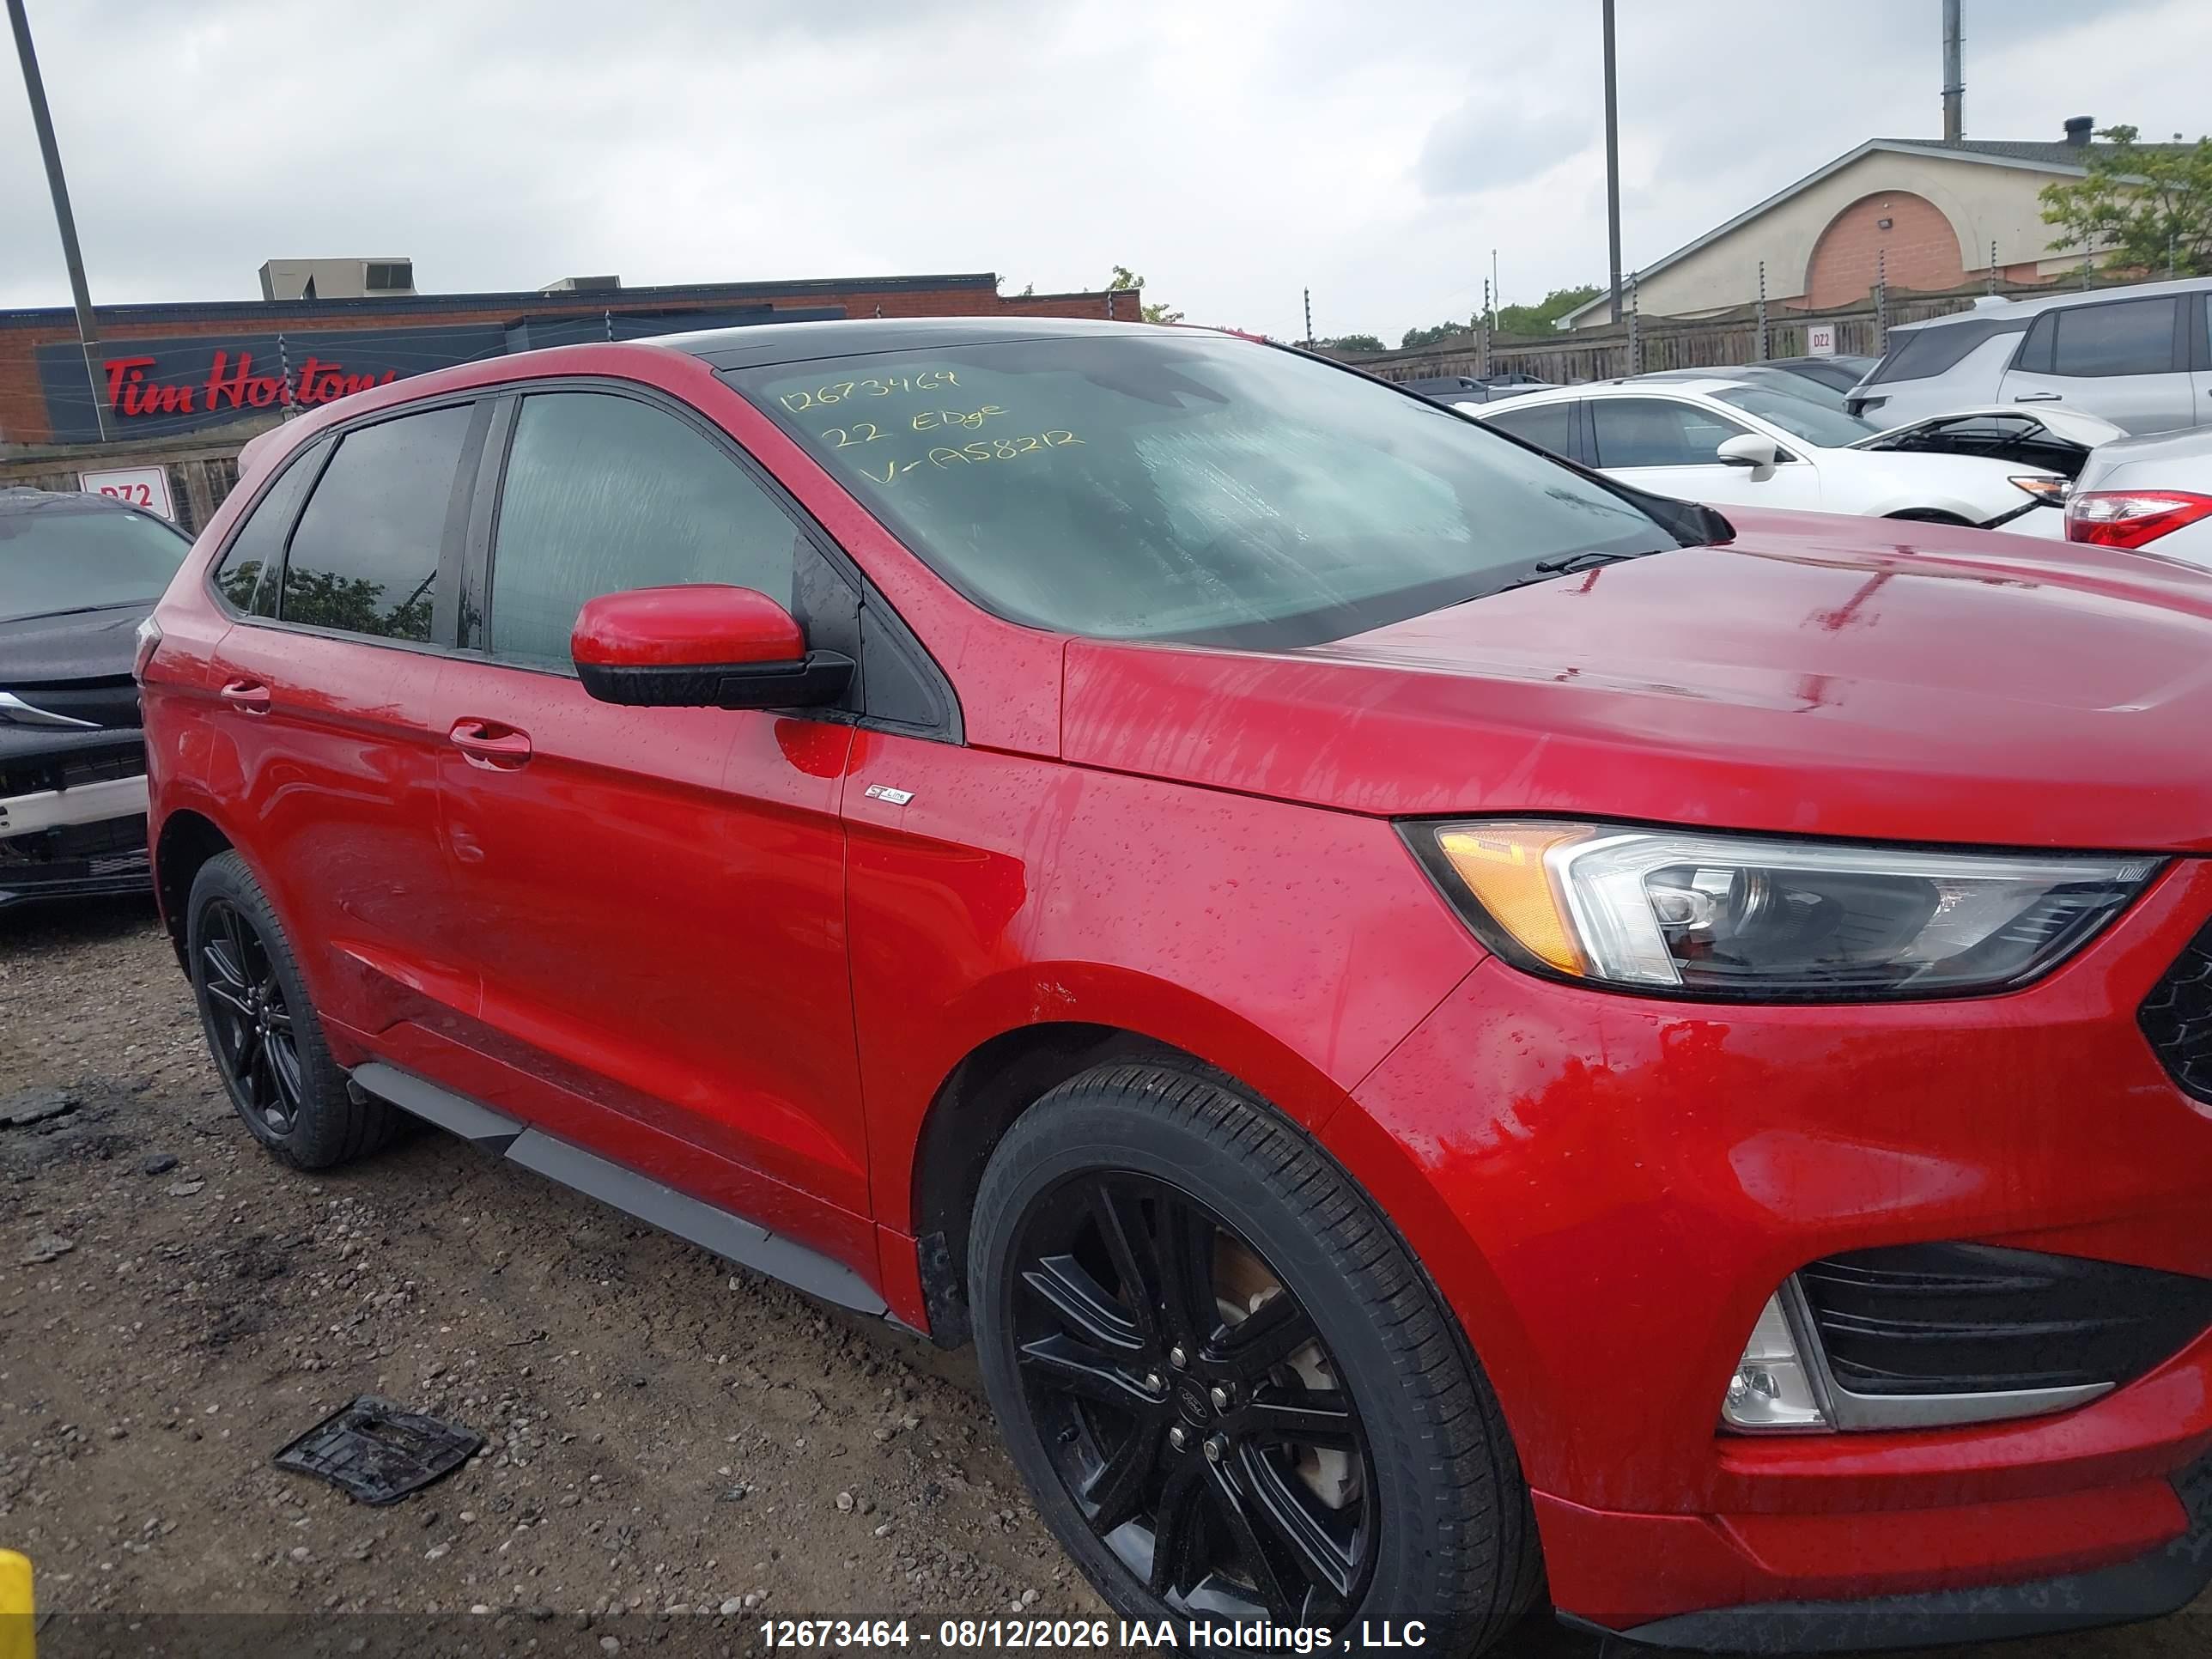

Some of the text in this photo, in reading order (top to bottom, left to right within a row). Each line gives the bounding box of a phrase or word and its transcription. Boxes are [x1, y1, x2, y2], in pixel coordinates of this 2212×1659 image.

[102, 356, 194, 416] Tim
[780, 371, 961, 413] 12673464
[821, 423, 893, 447] 22
[1182, 1392, 1202, 1414] Ford
